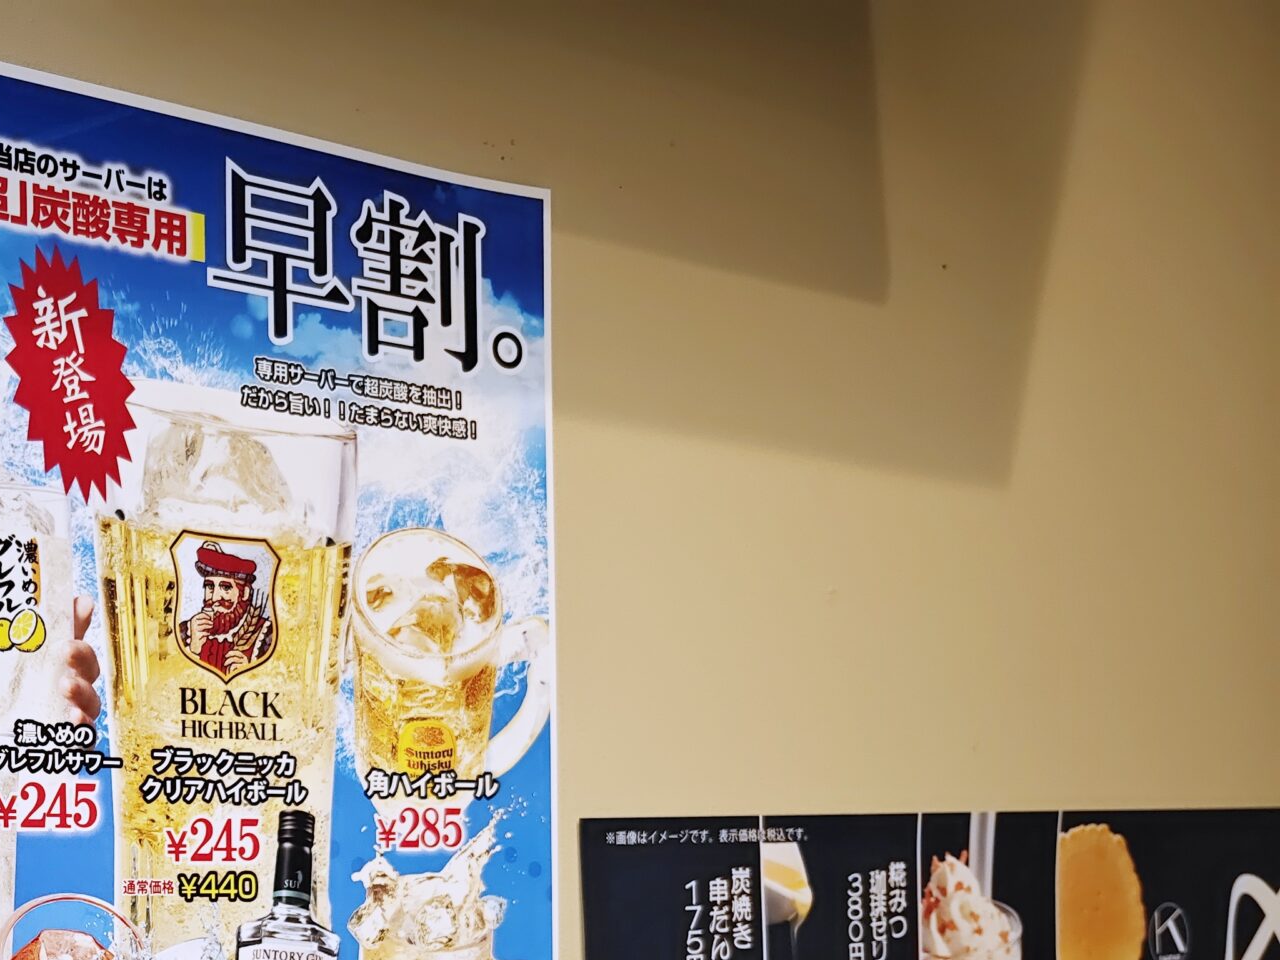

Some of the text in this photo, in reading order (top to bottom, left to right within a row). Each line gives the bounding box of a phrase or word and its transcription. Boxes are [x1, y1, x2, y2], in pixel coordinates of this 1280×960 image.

[31, 285, 106, 456] 新登場
[17, 540, 40, 606] 濃いめの
[179, 688, 282, 719] BLACK
[15, 721, 95, 748] 濃いめの
[180, 720, 283, 742] HIGHBALL
[151, 749, 297, 776] ブラックニッカ
[141, 778, 308, 805] クリアハイボール
[365, 768, 499, 799] 角ハイボール
[167, 818, 260, 862] ¥245
[378, 807, 462, 848] ¥285
[123, 871, 257, 901] 通常価格 ¥440
[731, 867, 752, 950] 炭焼き
